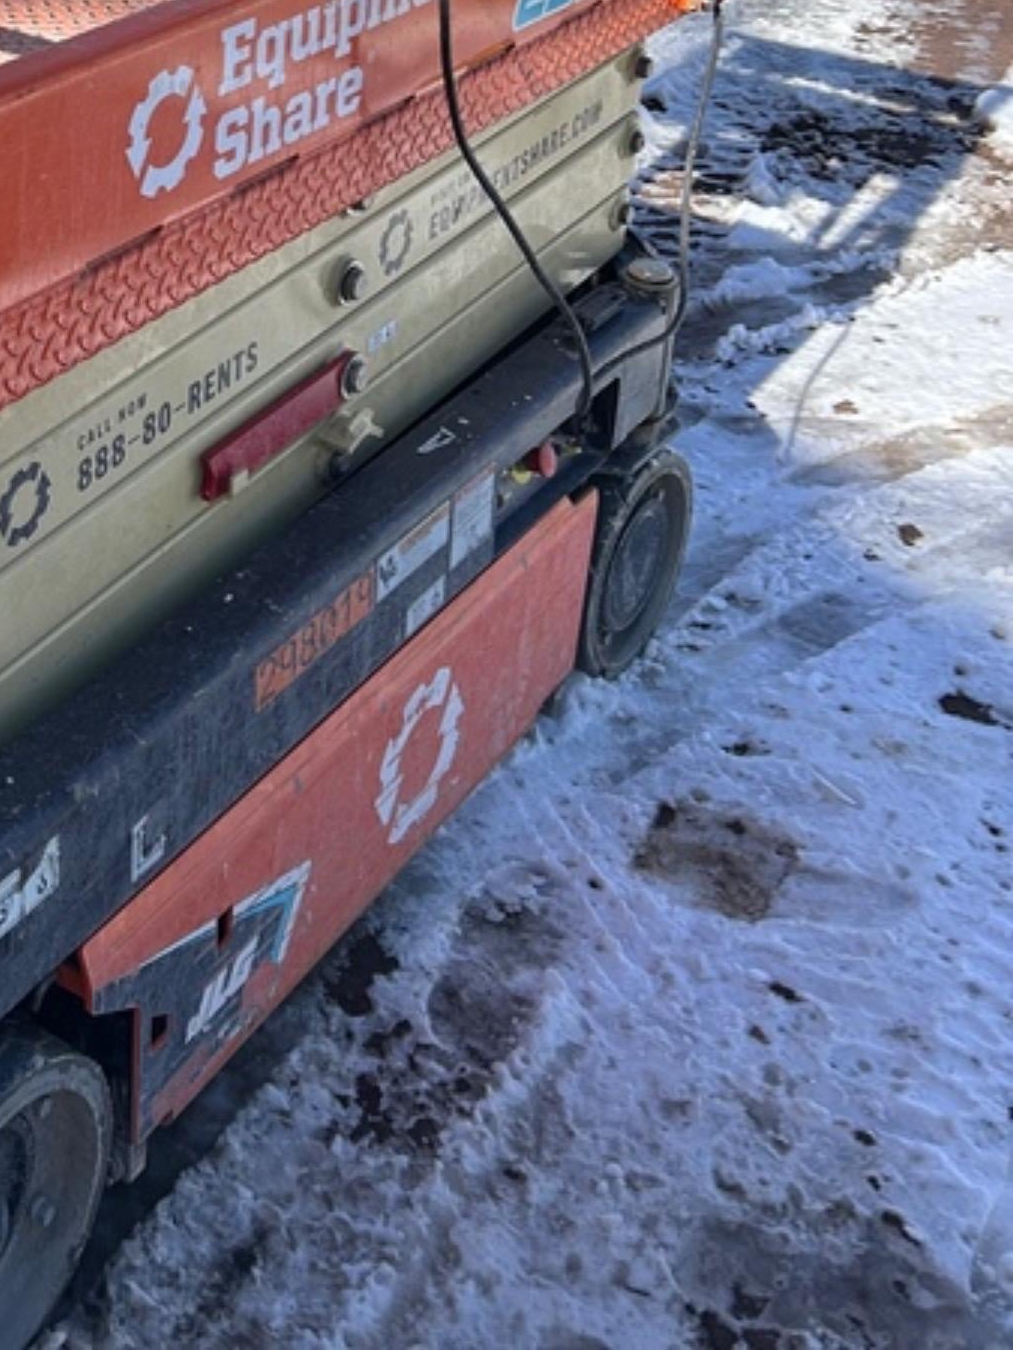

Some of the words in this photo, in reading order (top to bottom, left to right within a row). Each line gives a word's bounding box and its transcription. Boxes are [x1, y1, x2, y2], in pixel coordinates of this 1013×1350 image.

[214, 64, 364, 181] Share
[77, 341, 259, 492] 888-80-RENTS
[77, 418, 112, 450] CALL
[117, 392, 148, 422] NOW
